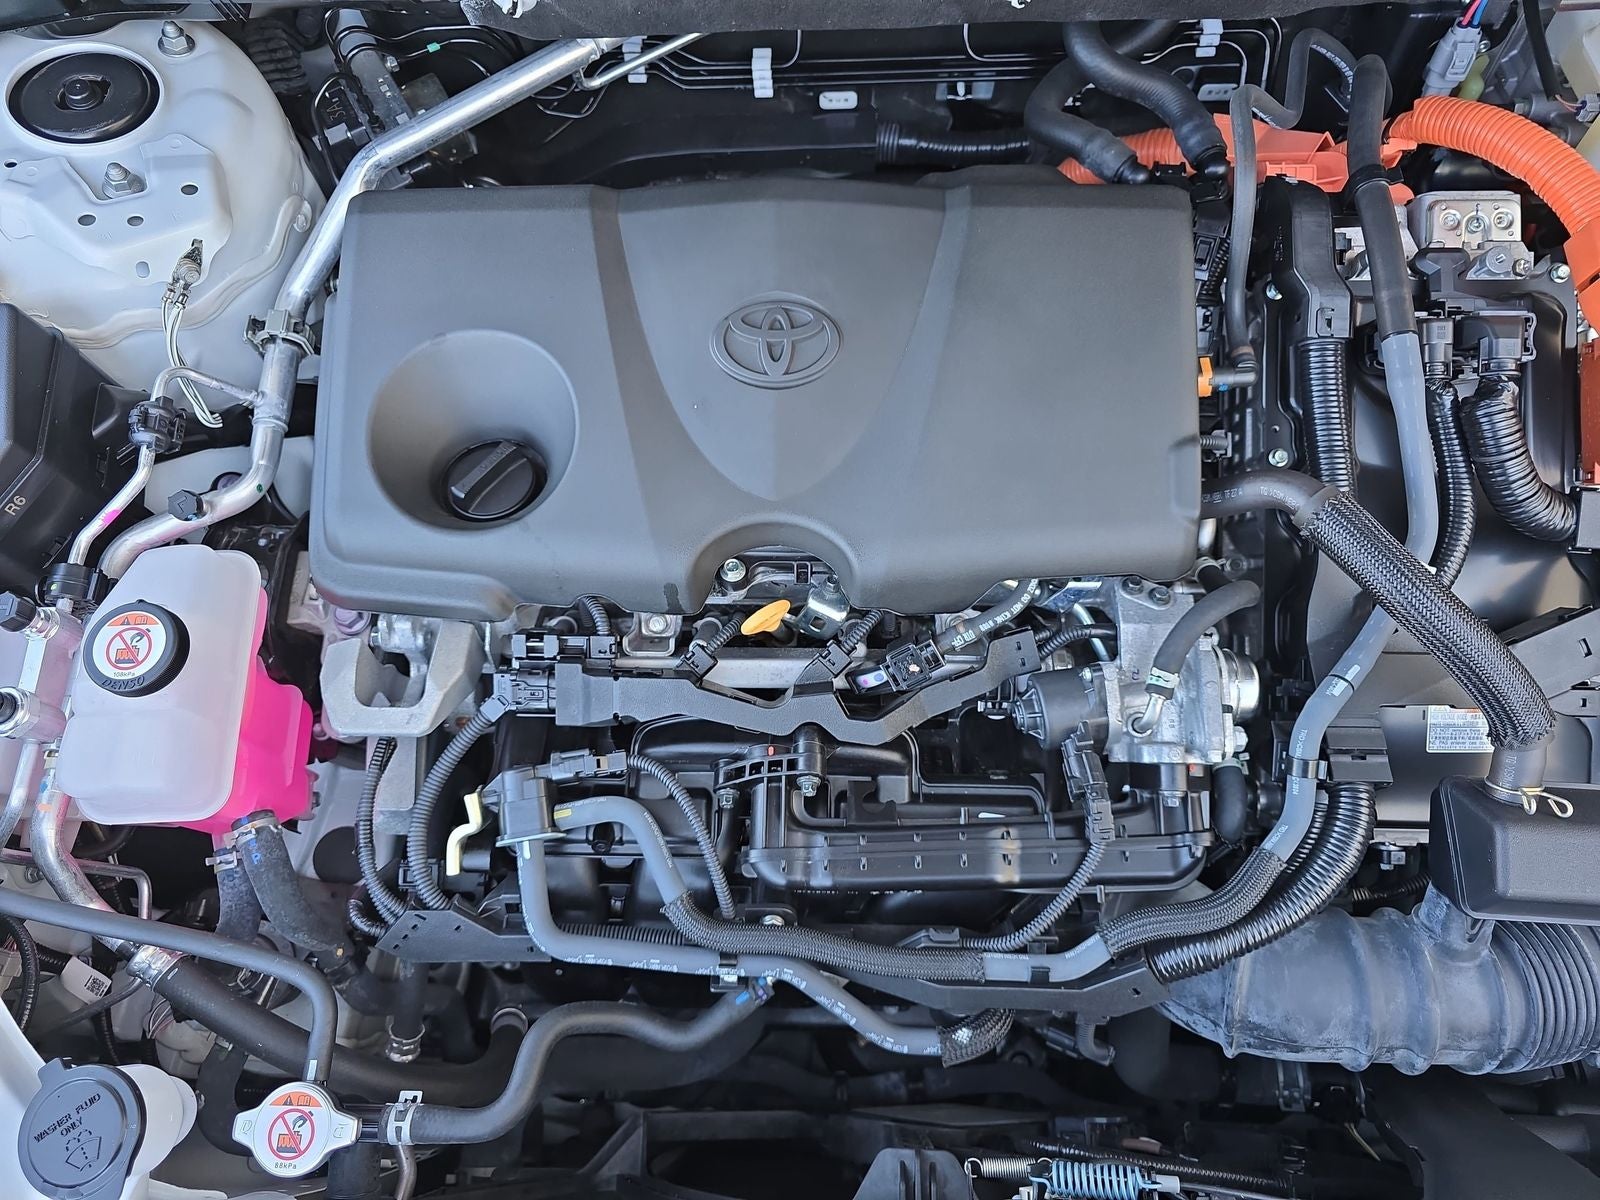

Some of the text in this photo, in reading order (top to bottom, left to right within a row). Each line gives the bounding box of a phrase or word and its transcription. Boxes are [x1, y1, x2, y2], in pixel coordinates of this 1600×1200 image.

[5, 495, 26, 516] R6
[101, 675, 145, 690] DENSO
[34, 1093, 101, 1143] WASHER FLUID
[60, 1116, 83, 1138] ONLY
[274, 1162, 297, 1170] 88kPa
